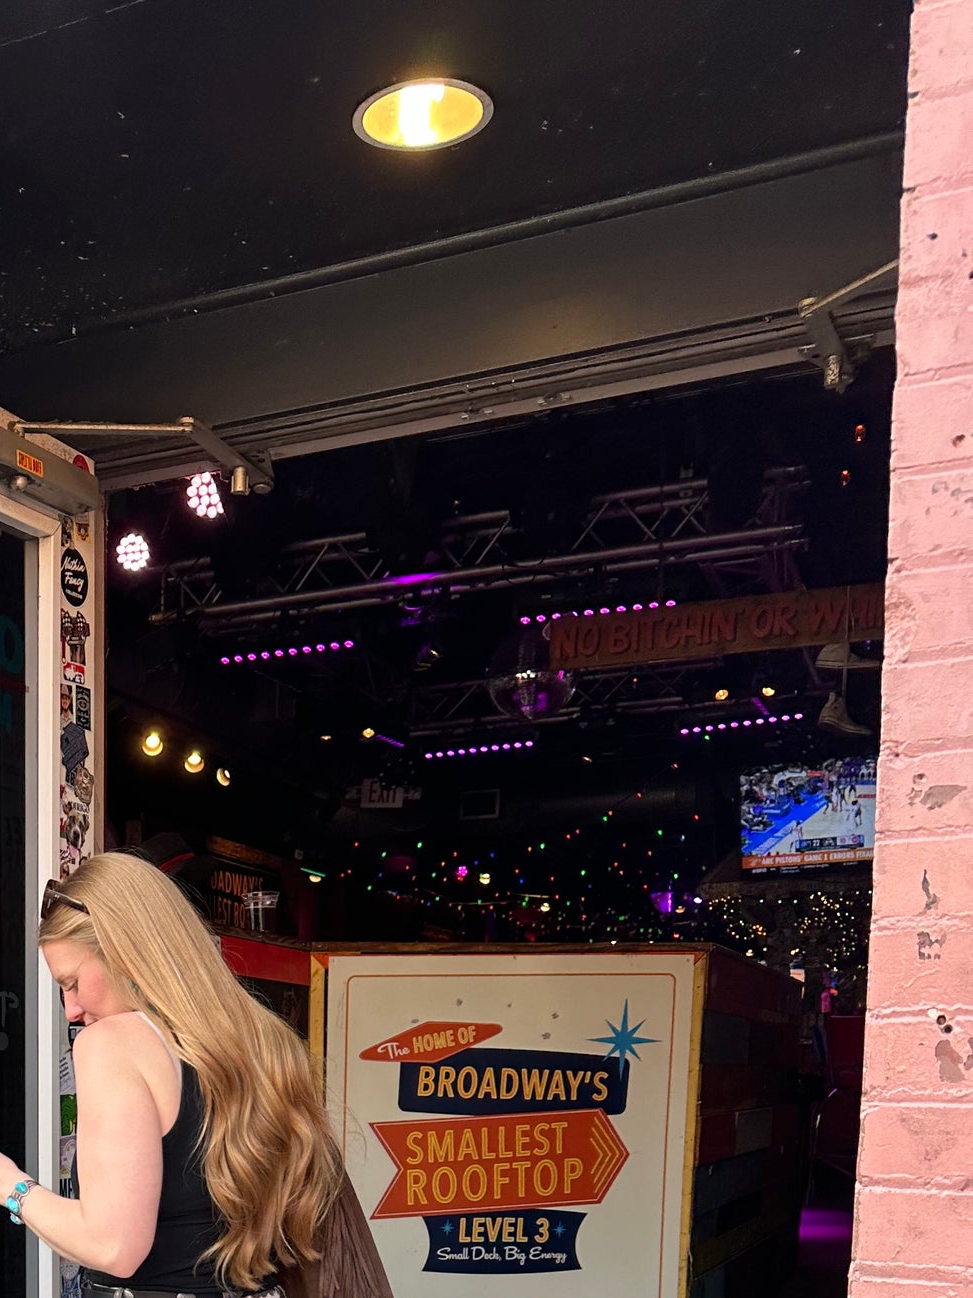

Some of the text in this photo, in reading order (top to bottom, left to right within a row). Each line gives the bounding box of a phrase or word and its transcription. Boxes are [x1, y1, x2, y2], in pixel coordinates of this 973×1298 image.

[553, 627, 601, 660] NO
[750, 604, 800, 640] OR
[377, 1025, 477, 1060] The HOME OF
[416, 1065, 609, 1102] BROADWAY'S
[406, 1121, 569, 1165] SMALLEST
[406, 1157, 583, 1206] ROOFTOP
[458, 1217, 550, 1244] LEVEL 3
[436, 1245, 470, 1262] Small
[503, 1246, 526, 1266] Big
[528, 1246, 569, 1265] Energy
